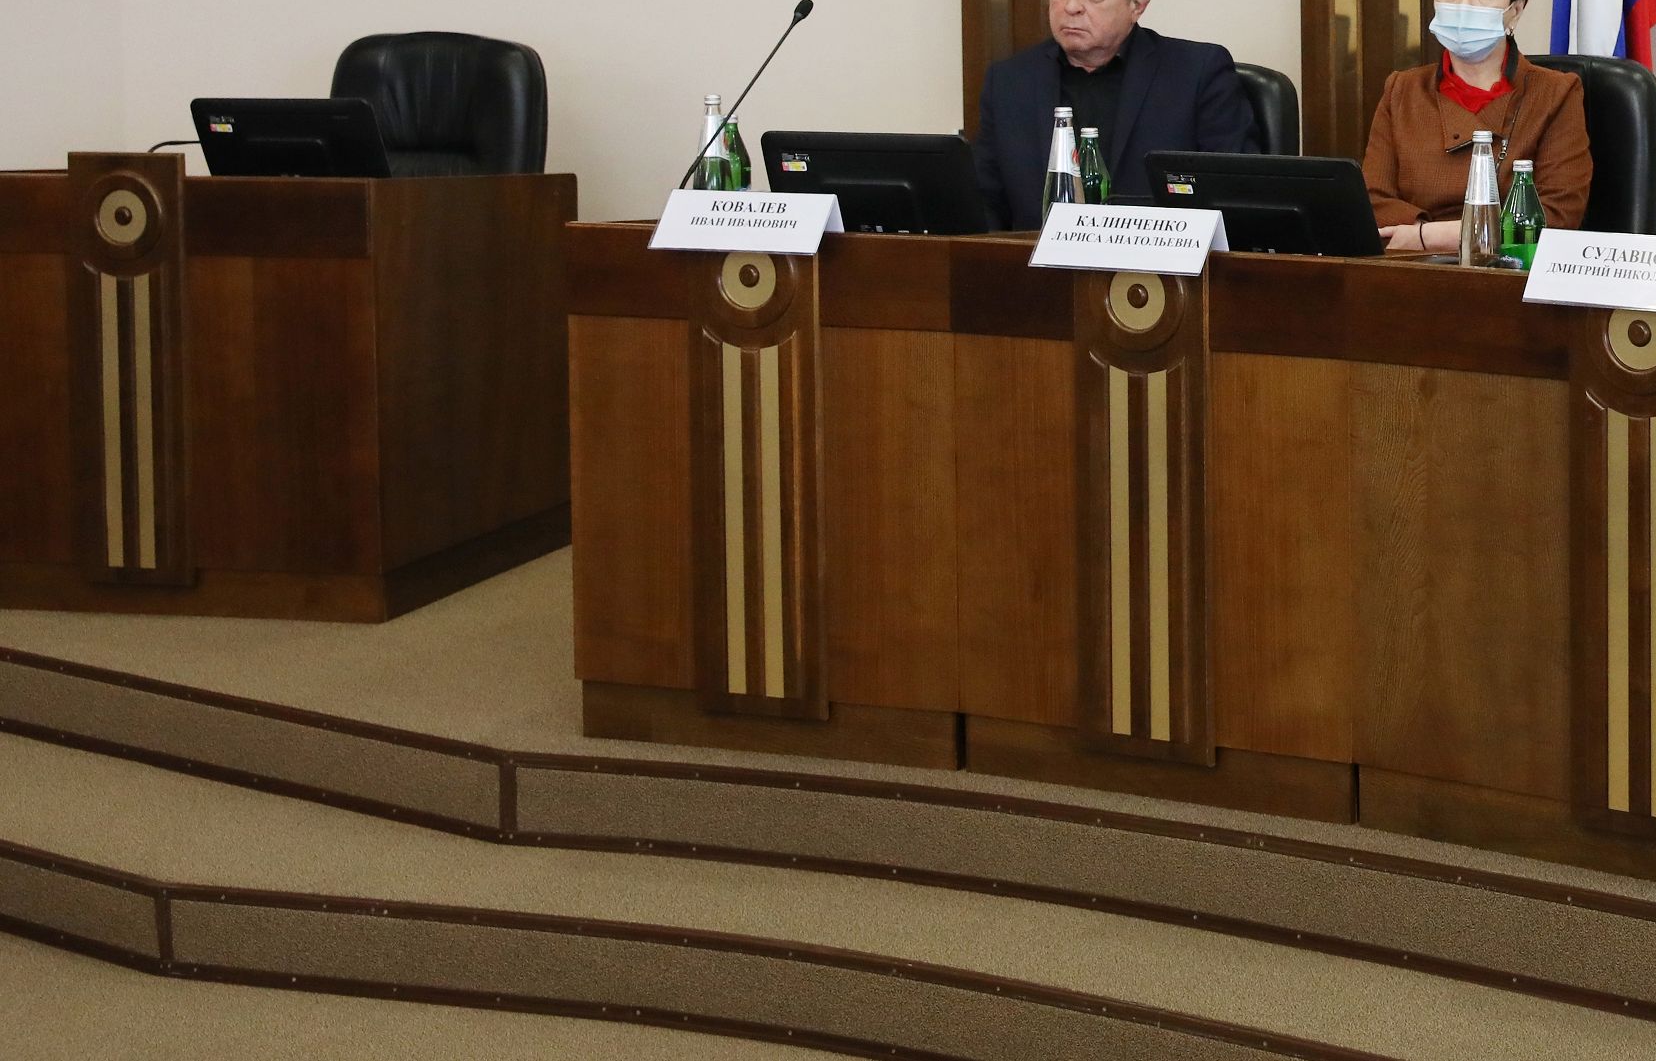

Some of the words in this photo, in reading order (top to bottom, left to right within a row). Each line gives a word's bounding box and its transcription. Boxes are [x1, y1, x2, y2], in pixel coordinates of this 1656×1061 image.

[711, 200, 787, 214] КОВАЛЕВ
[690, 216, 726, 227] ИВАН
[727, 218, 799, 230] ИВАНОВИЧ
[1076, 215, 1188, 233] КАЛИНЧЕНКО
[1051, 231, 1103, 244] ЛАРИСА
[1104, 234, 1201, 249] АНАТОЛЬЕВНА
[1546, 261, 1611, 278] ДМИТРИЙ
